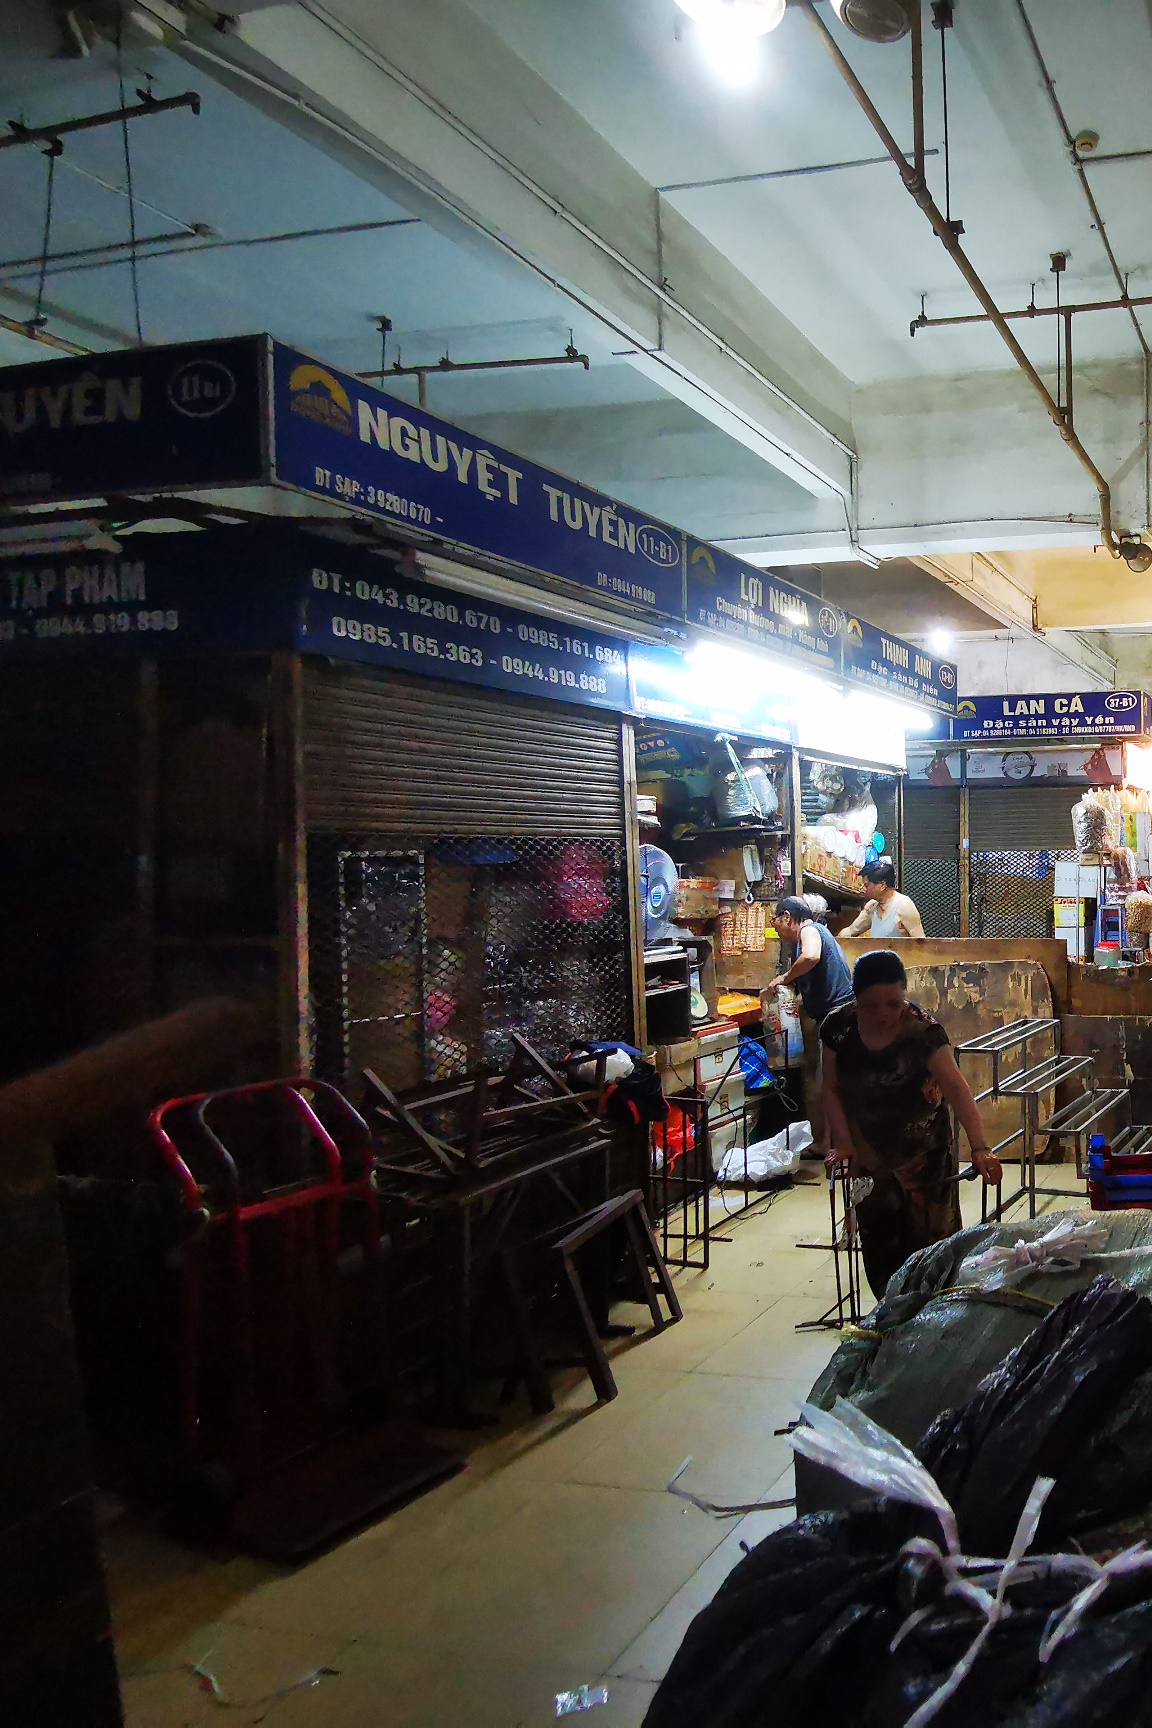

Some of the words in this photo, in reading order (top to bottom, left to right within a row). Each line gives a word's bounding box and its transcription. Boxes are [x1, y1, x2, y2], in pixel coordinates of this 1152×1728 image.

[358, 399, 523, 506] NGUYỆT
[541, 483, 636, 554] TUYẾN
[642, 533, 672, 563] 11-B1
[740, 573, 763, 608] LỢI
[355, 579, 500, 634] 043.9280.670
[517, 623, 623, 664] 0985.161.684
[716, 596, 748, 621] Chuyên
[332, 616, 484, 667] 0985.165.363
[502, 655, 607, 694] 0944.919.888
[880, 637, 909, 669] THỊNH
[914, 654, 932, 679] ANH
[1003, 698, 1045, 716] LAN
[1054, 695, 1085, 714] CÁ
[1109, 697, 1133, 708] 37-B1
[983, 719, 1014, 730] Đặc
[1018, 717, 1047, 727] sản
